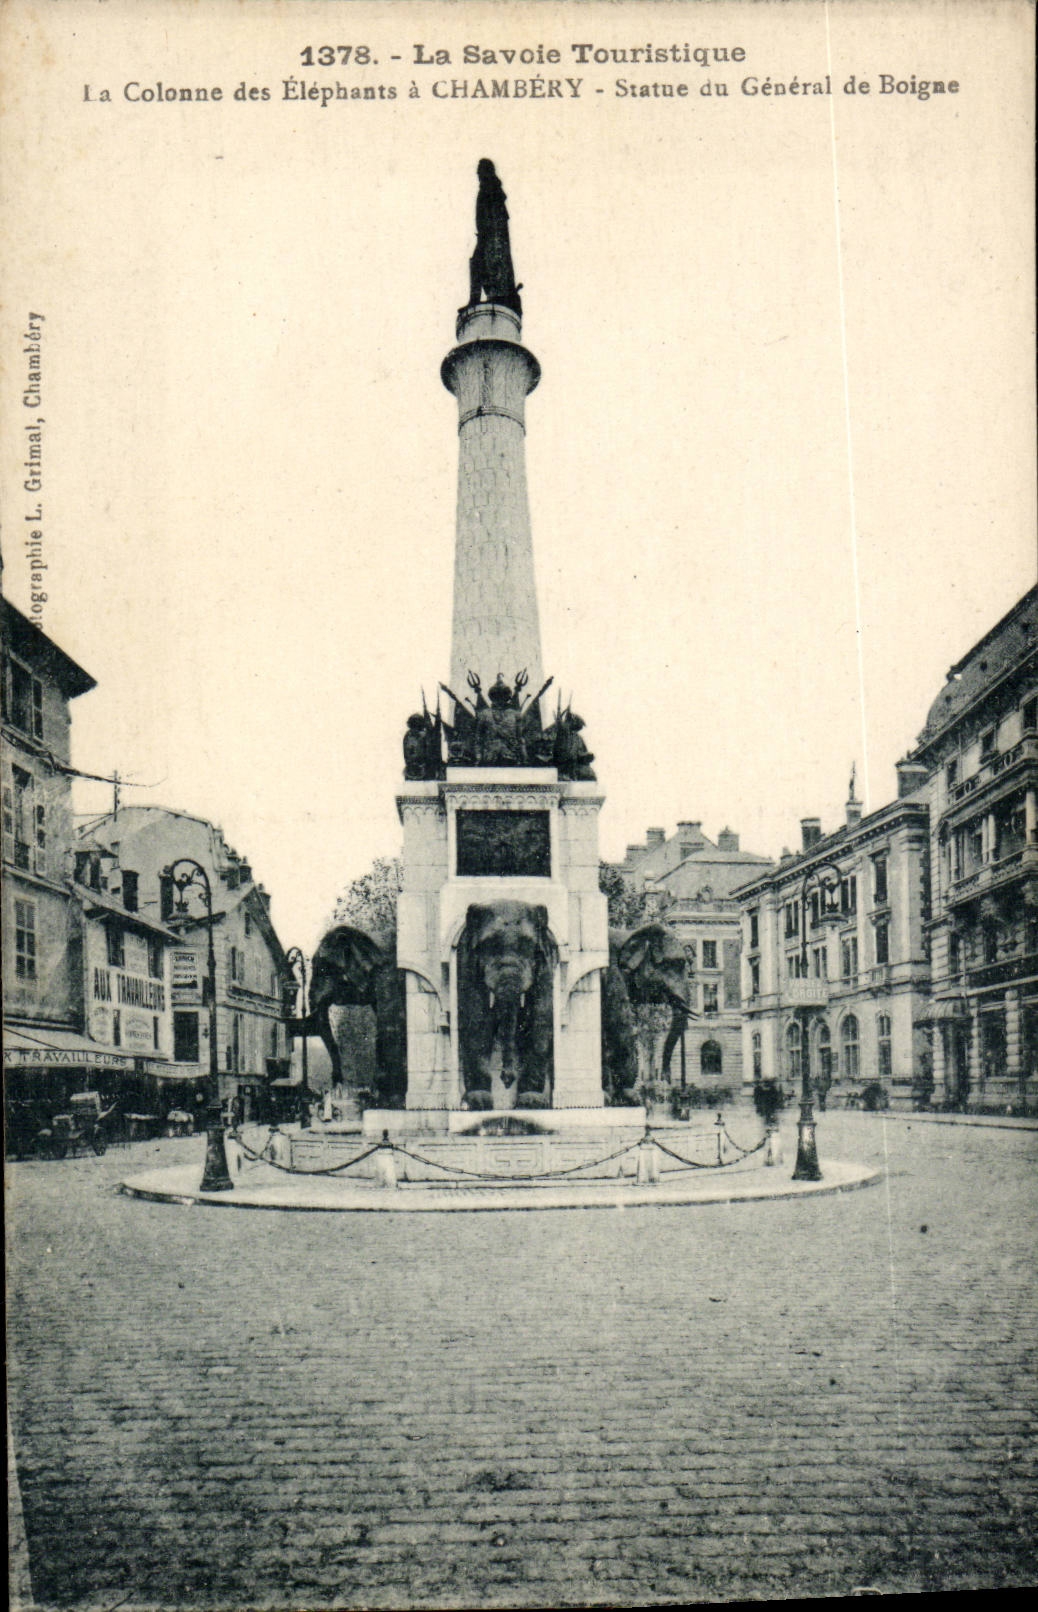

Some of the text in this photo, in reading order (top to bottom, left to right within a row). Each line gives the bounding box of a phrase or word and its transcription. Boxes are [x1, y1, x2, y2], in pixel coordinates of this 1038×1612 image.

[94, 967, 165, 1012] AUX TRAVAILLEURS
[21, 1050, 127, 1067] TRAVAILLEURS
